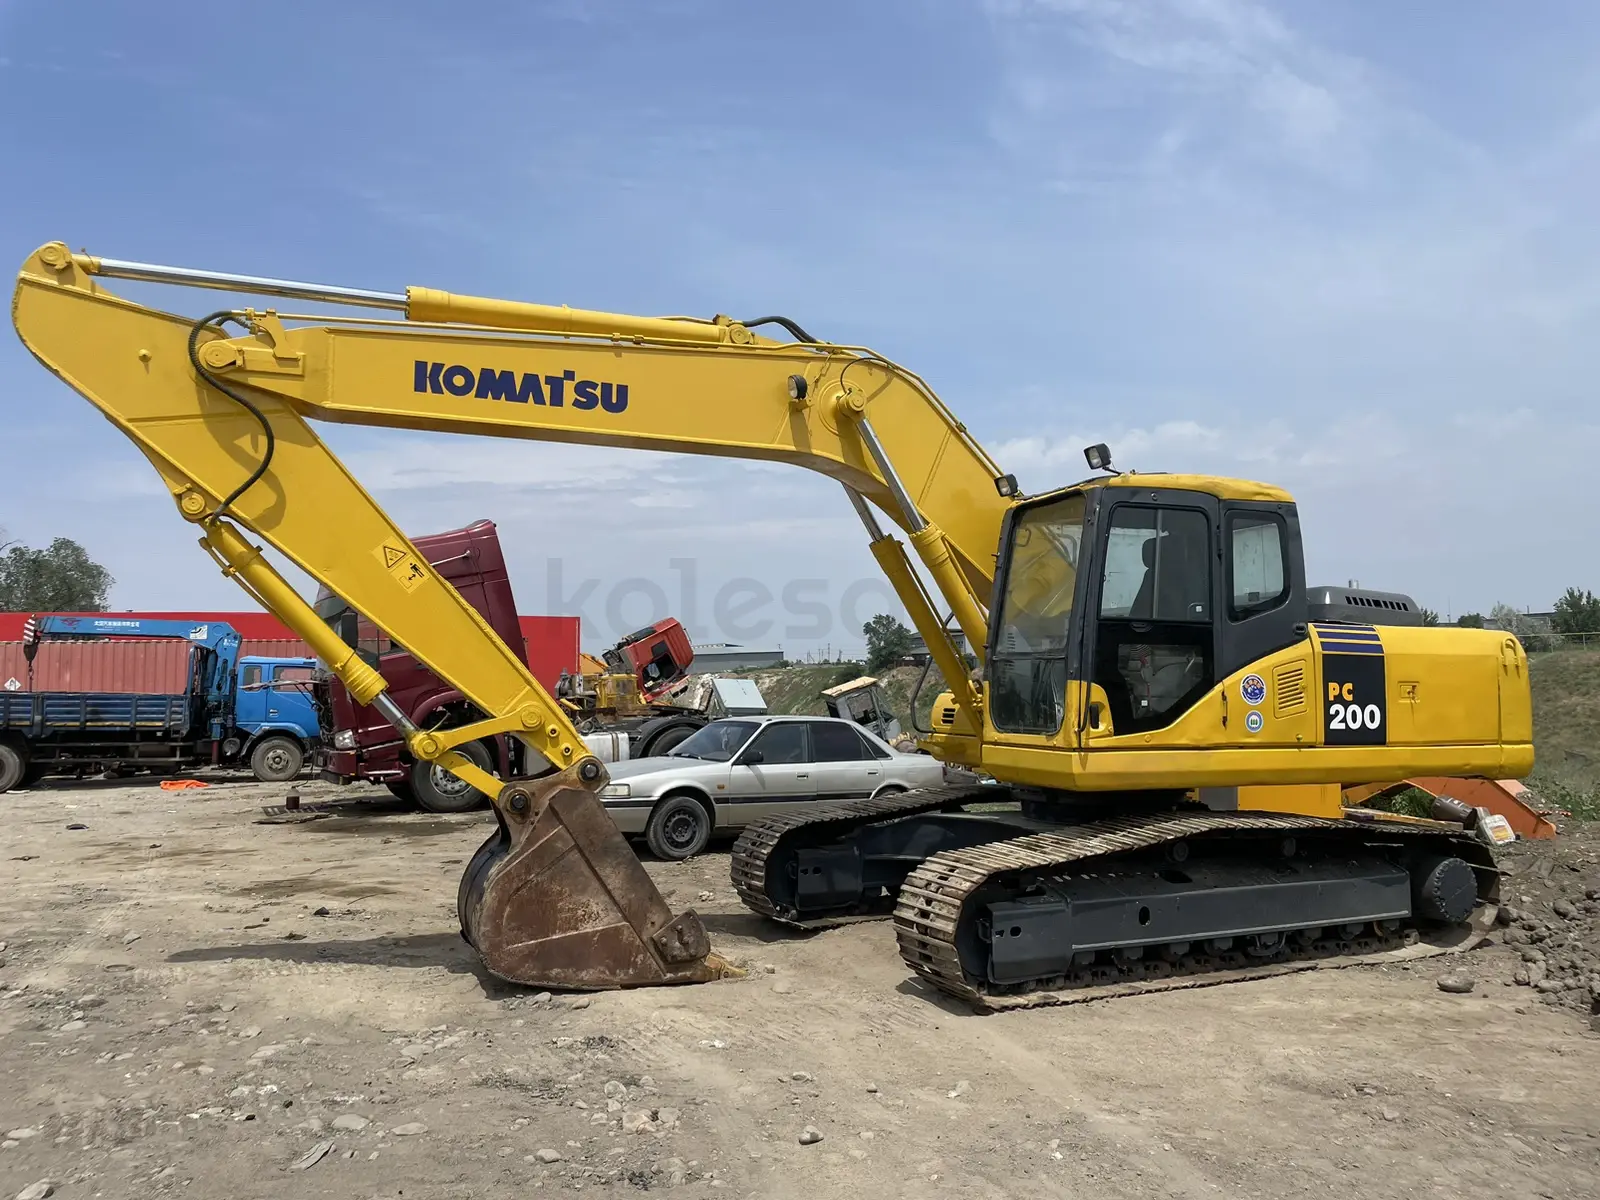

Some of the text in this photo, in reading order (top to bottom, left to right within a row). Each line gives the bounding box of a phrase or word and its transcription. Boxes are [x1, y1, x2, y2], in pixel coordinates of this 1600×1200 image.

[414, 360, 628, 413] KOMATSU
[1328, 682, 1353, 701] PC
[1329, 704, 1381, 730] 200
